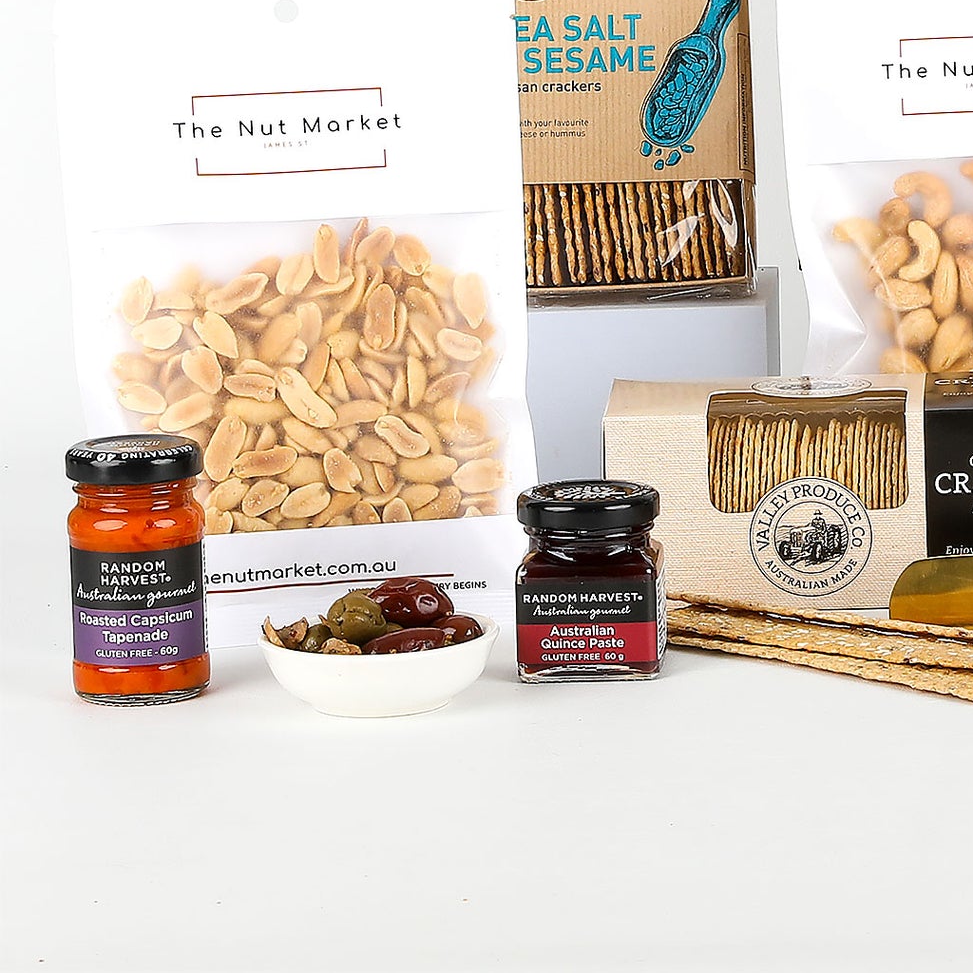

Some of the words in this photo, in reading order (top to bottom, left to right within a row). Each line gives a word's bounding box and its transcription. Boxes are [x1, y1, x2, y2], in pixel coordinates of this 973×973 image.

[515, 15, 554, 42] EA
[563, 14, 642, 42] SALT
[523, 45, 656, 74] SESAME
[881, 63, 928, 80] The
[542, 80, 602, 92] crackers
[172, 122, 222, 139] The
[239, 119, 287, 137] Nut
[302, 113, 402, 135] Market
[534, 120, 552, 129] your
[554, 119, 589, 127] favourite
[263, 141, 294, 149] JAMES
[96, 451, 117, 462] 40
[121, 445, 193, 460] CELEBRATING
[755, 490, 790, 552] VALLEY
[791, 484, 862, 525] PRODUCE
[100, 560, 166, 574] RANDOM
[765, 560, 829, 589] AUSTRALIAN
[830, 558, 858, 585] MADE
[452, 581, 487, 590] BEGINS
[76, 583, 146, 602] Australian
[146, 580, 198, 607] gourmet
[523, 593, 577, 604] RANDOM
[79, 611, 127, 627] Roasted
[130, 609, 194, 628] Capsicum
[532, 604, 589, 617] Australian
[589, 604, 632, 620] gourmet
[102, 629, 169, 645] Tapenade
[549, 625, 615, 637] Australian
[540, 637, 586, 650] Quince
[588, 637, 625, 649] Paste
[95, 649, 128, 659] GLUTEN
[129, 648, 153, 658] FREE
[159, 645, 179, 656] 60g
[541, 652, 577, 662] GLUTEN
[578, 652, 601, 661] FREE
[604, 652, 617, 661] 60
